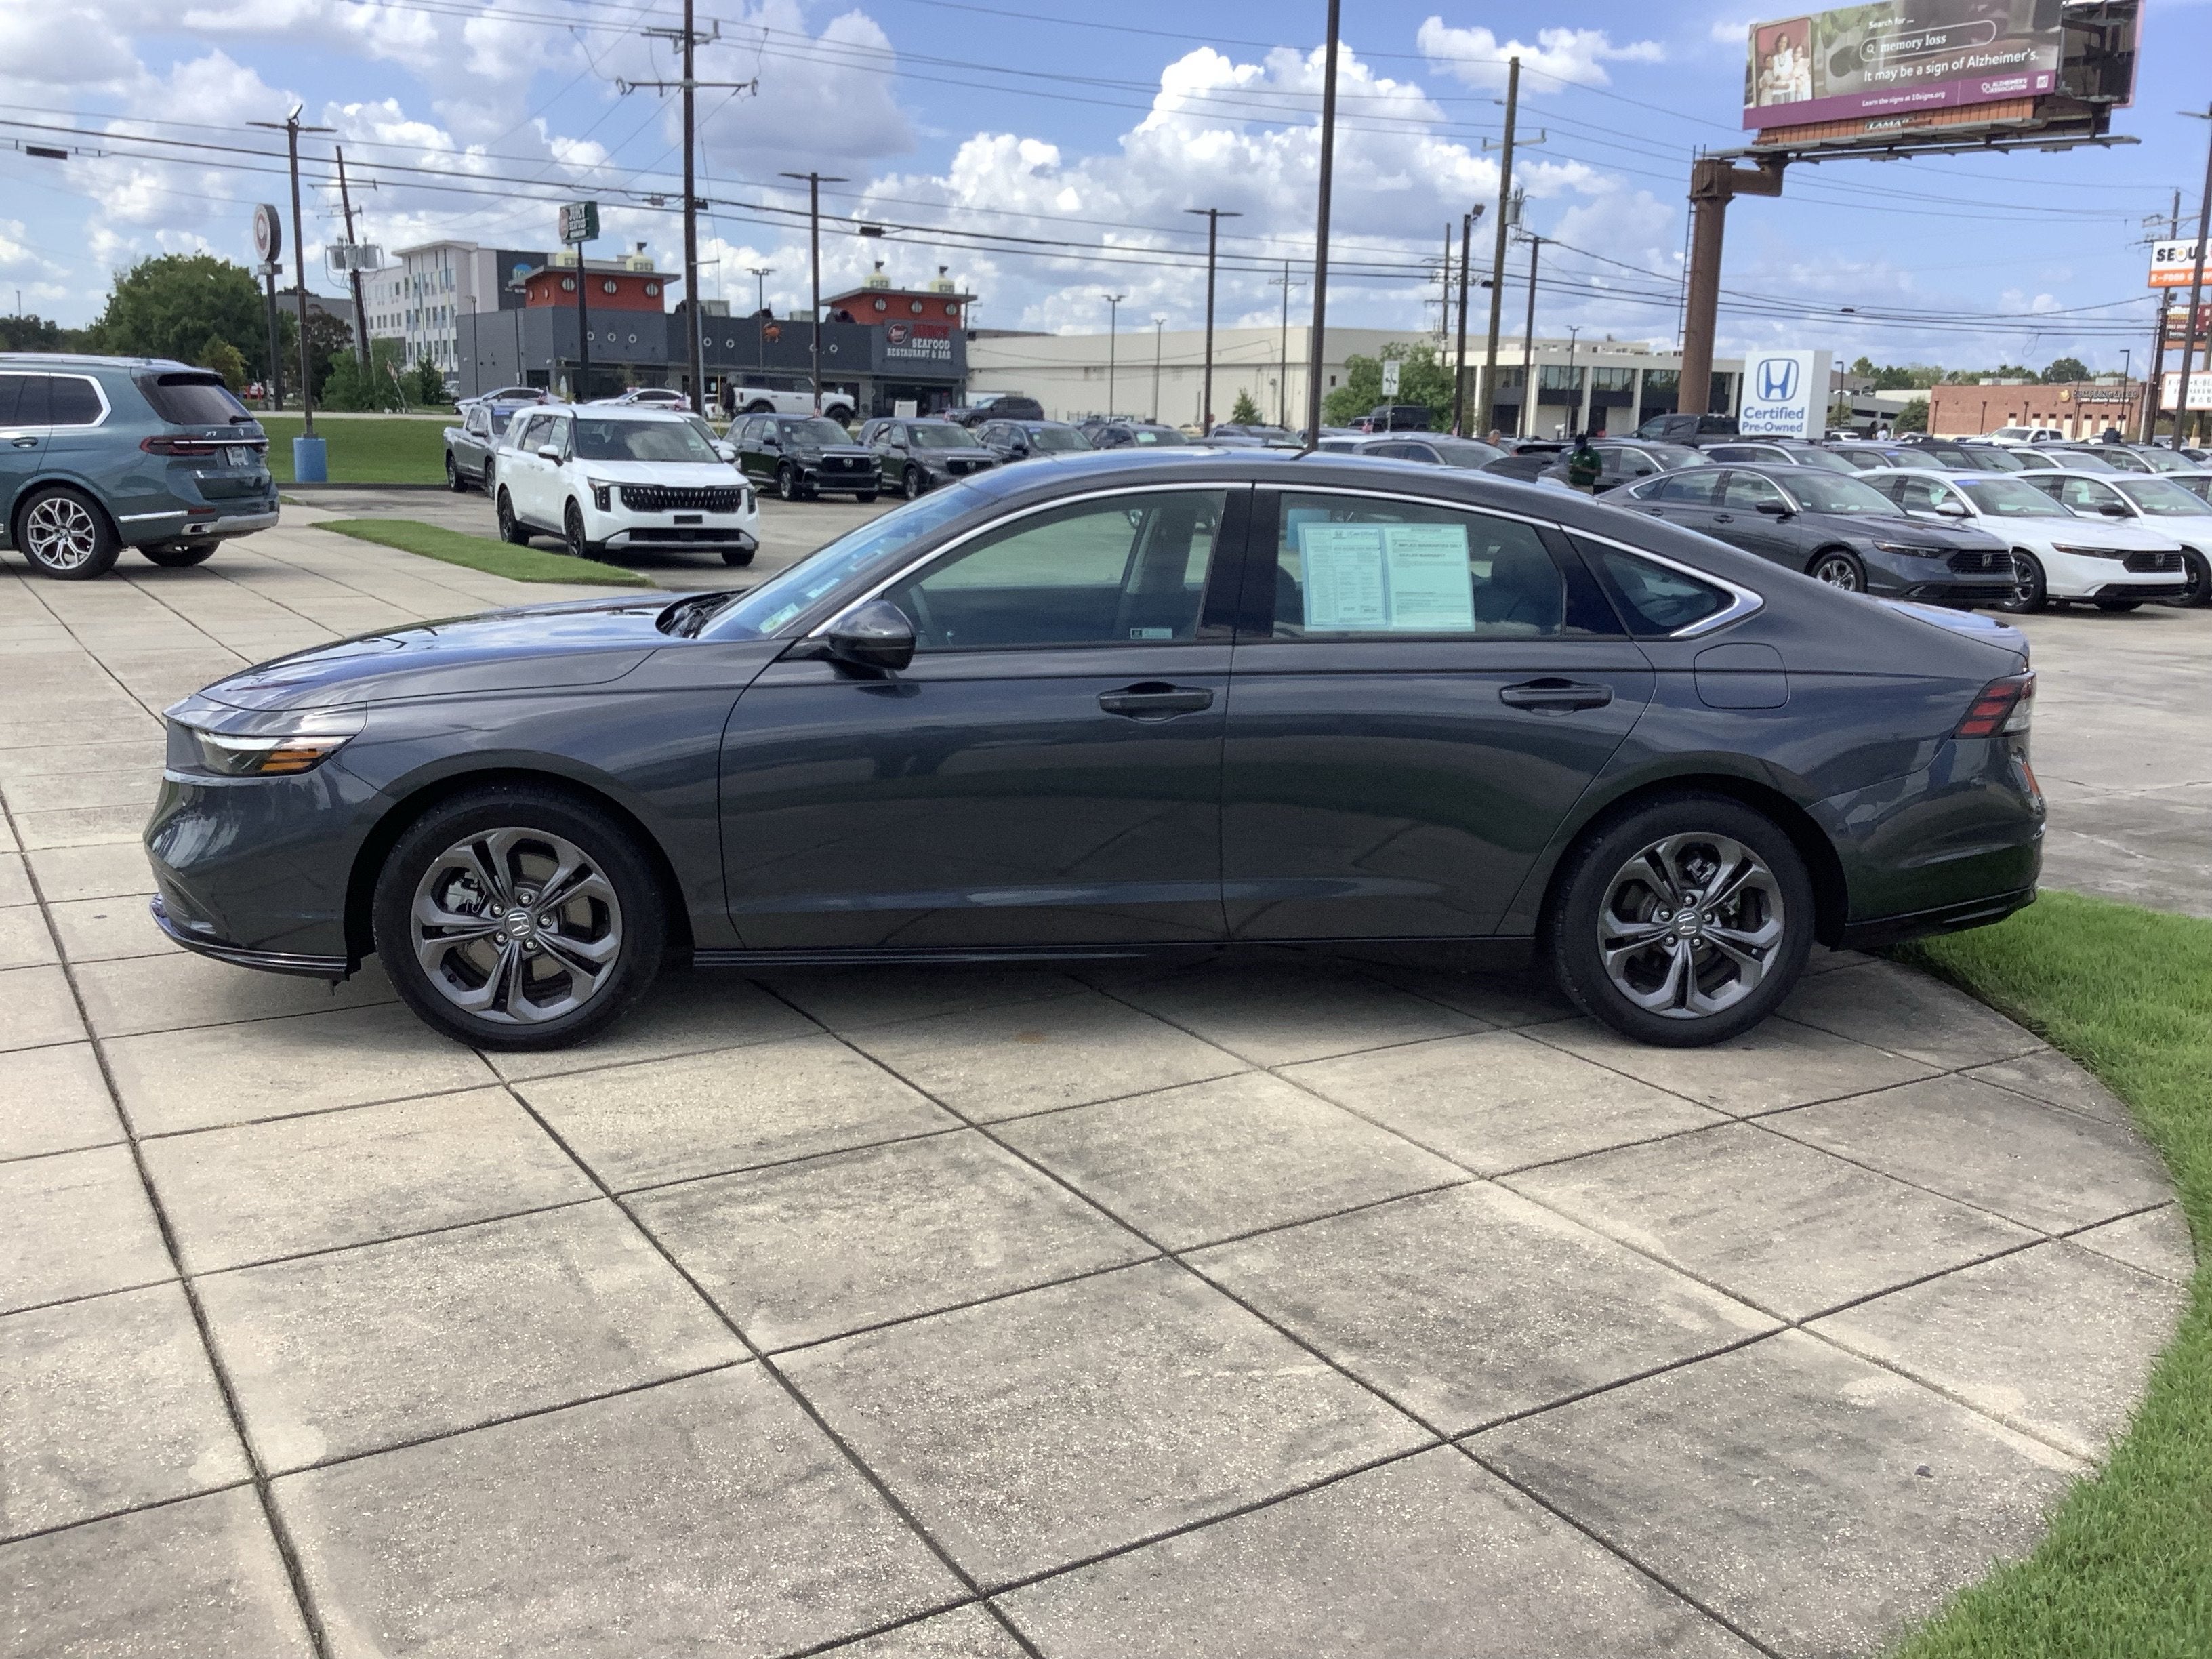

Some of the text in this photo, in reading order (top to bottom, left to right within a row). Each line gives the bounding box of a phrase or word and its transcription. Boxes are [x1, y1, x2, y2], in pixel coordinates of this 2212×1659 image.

[1868, 19, 1893, 29] Search
[1894, 17, 1906, 25] for
[1881, 34, 1946, 51] memory loss
[1864, 47, 2039, 81] It may be a sign of Alzheimer's.
[1889, 96, 1904, 104] signs
[2156, 247, 2208, 262] SEOU
[912, 337, 951, 350] SEAFOOD
[887, 347, 951, 359] RESTAURANT & BAR
[1744, 406, 1805, 419] Certified
[1742, 422, 1803, 432] Pre-Owned
